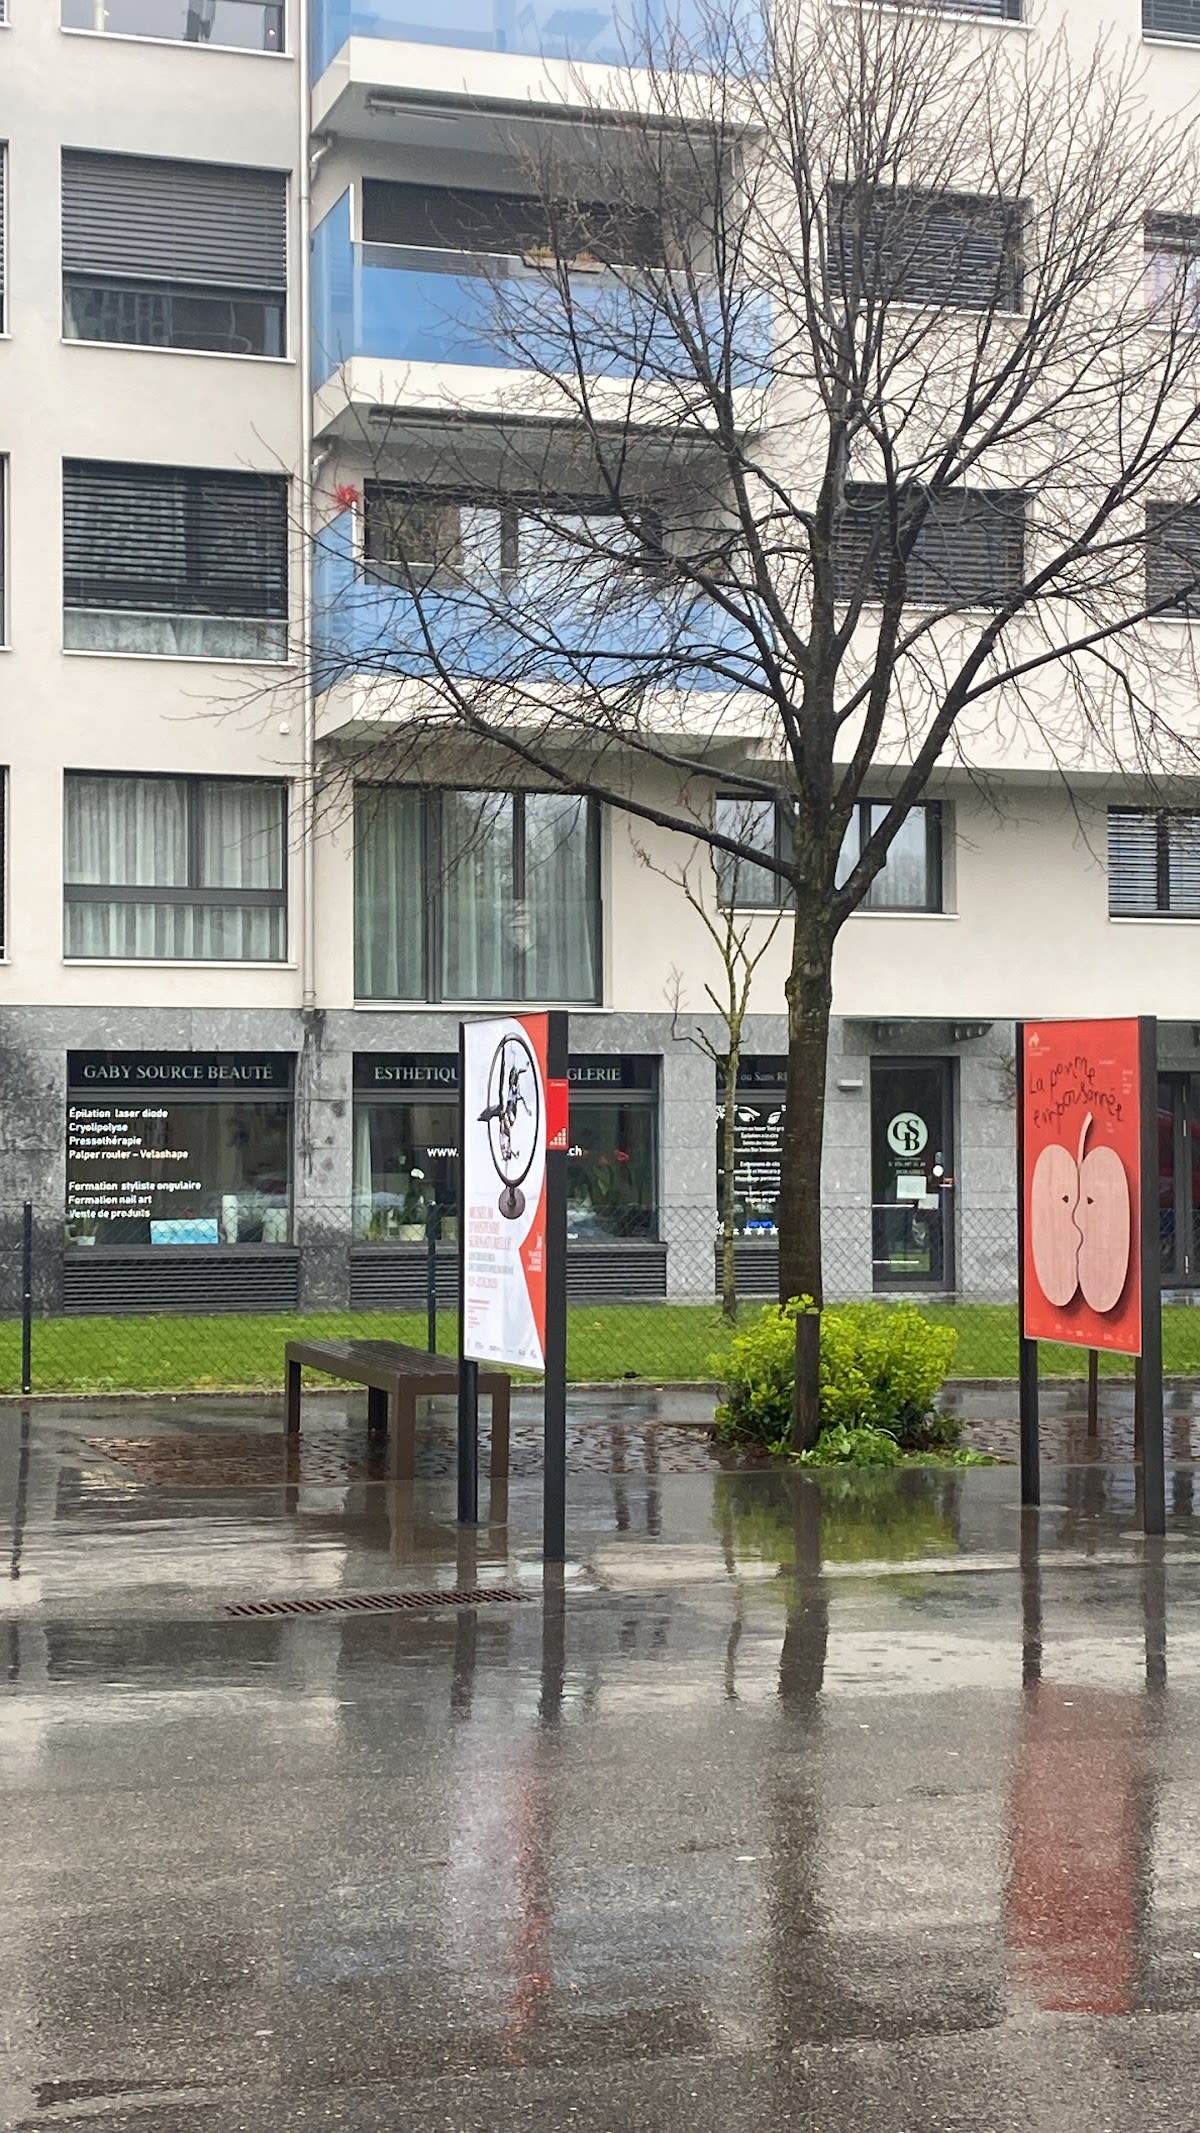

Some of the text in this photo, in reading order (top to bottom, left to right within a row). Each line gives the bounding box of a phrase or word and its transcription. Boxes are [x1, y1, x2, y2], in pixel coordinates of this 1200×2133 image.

[84, 1063, 273, 1079] GABY SOURCE BEAUTÉ
[374, 1067, 621, 1082] ESTHETIQU GLERIE
[69, 1107, 168, 1119] Épilation laser diode
[69, 1123, 128, 1133] Cryolipolyse
[69, 1135, 142, 1147] Pressothérapie
[69, 1150, 100, 1160] Palper
[101, 1150, 131, 1159] rouler
[69, 1181, 201, 1192] Formation styliste ongulaire
[68, 1195, 152, 1205] Formation nail art
[69, 1209, 151, 1220] Vente de produits
